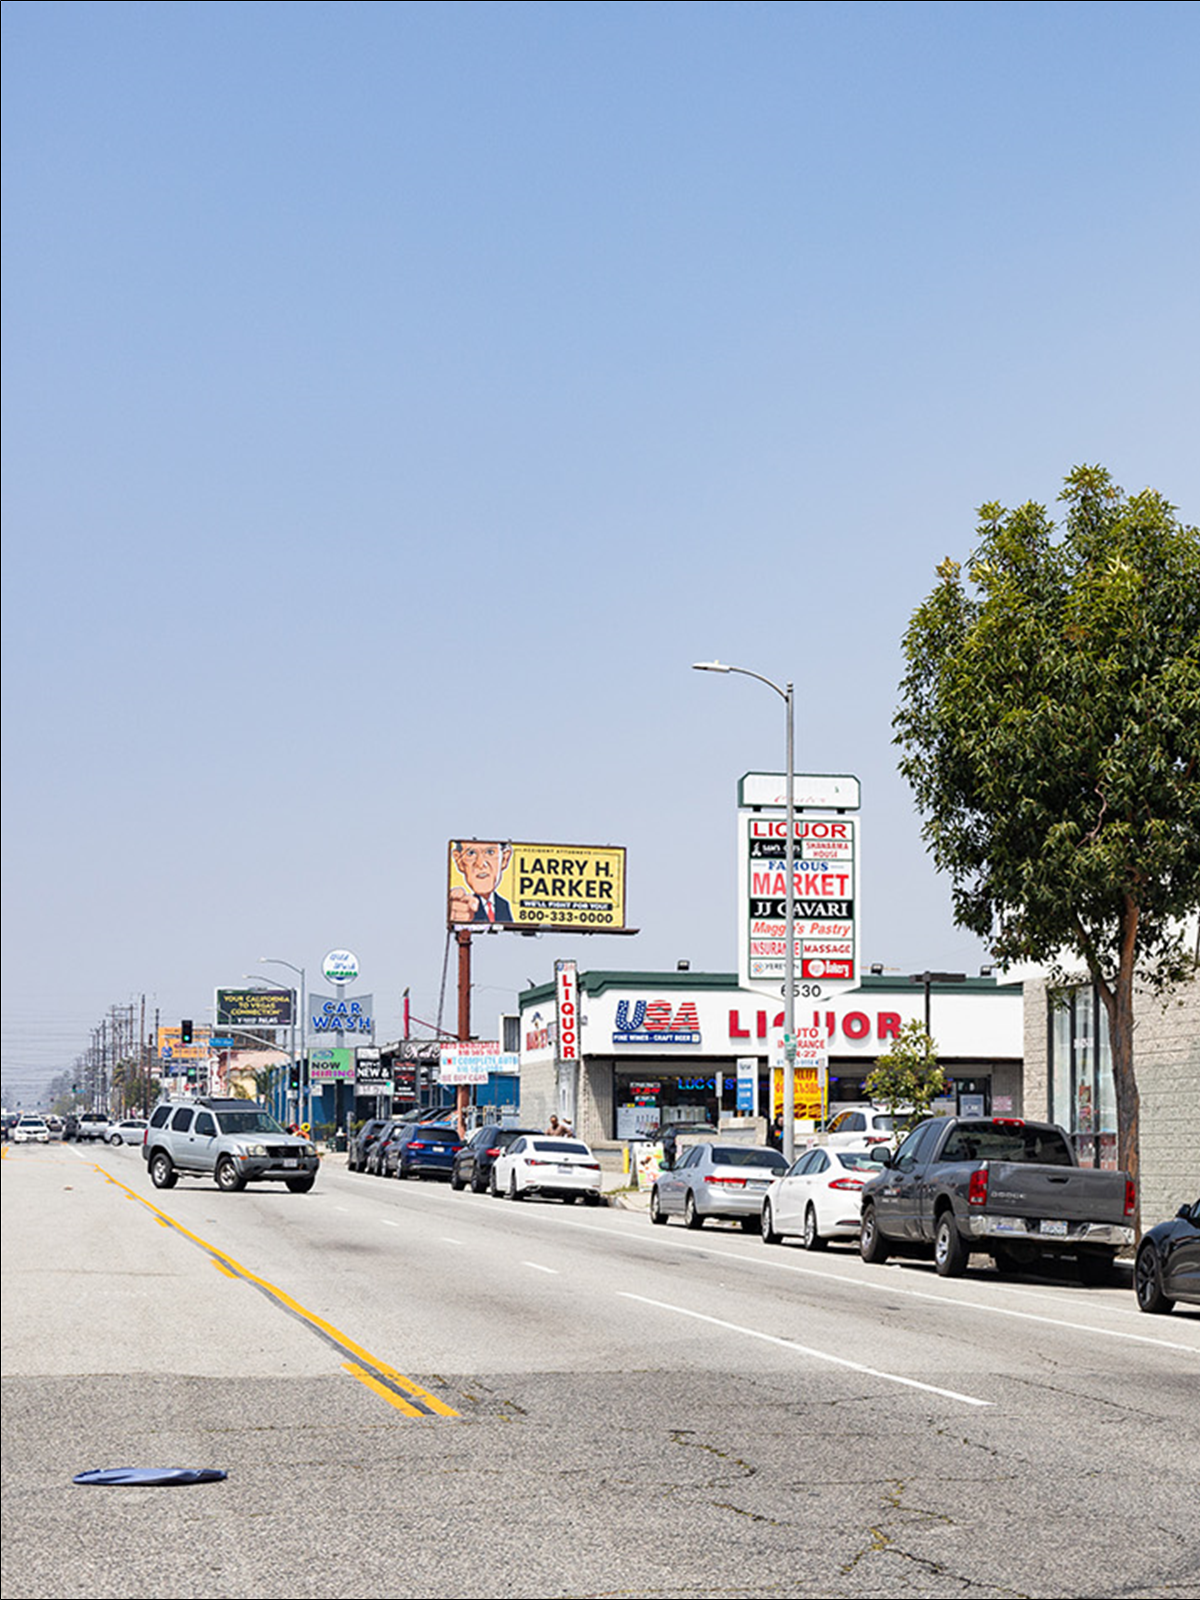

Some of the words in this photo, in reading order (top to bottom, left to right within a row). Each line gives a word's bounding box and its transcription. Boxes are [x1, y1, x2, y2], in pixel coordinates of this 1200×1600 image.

[519, 857, 589, 876] LARRY
[595, 860, 614, 878] H.
[519, 877, 613, 899] PARKER
[753, 872, 849, 896] MARKET
[754, 901, 772, 916] JJ
[519, 910, 613, 923] 800-333-0000
[752, 921, 805, 937] Magg's
[809, 922, 851, 937] Pastry
[750, 942, 800, 955] INSURANE
[804, 944, 851, 953] MASSAGE
[323, 1001, 361, 1014] CAR
[312, 1016, 371, 1029] WASH
[560, 974, 576, 1058] LIQUOR
[615, 999, 700, 1032] USA
[729, 1010, 902, 1039] LIUOR
[793, 1028, 819, 1038] UTO
[777, 1039, 825, 1049] INRANCE
[311, 1070, 355, 1078] HIRING
